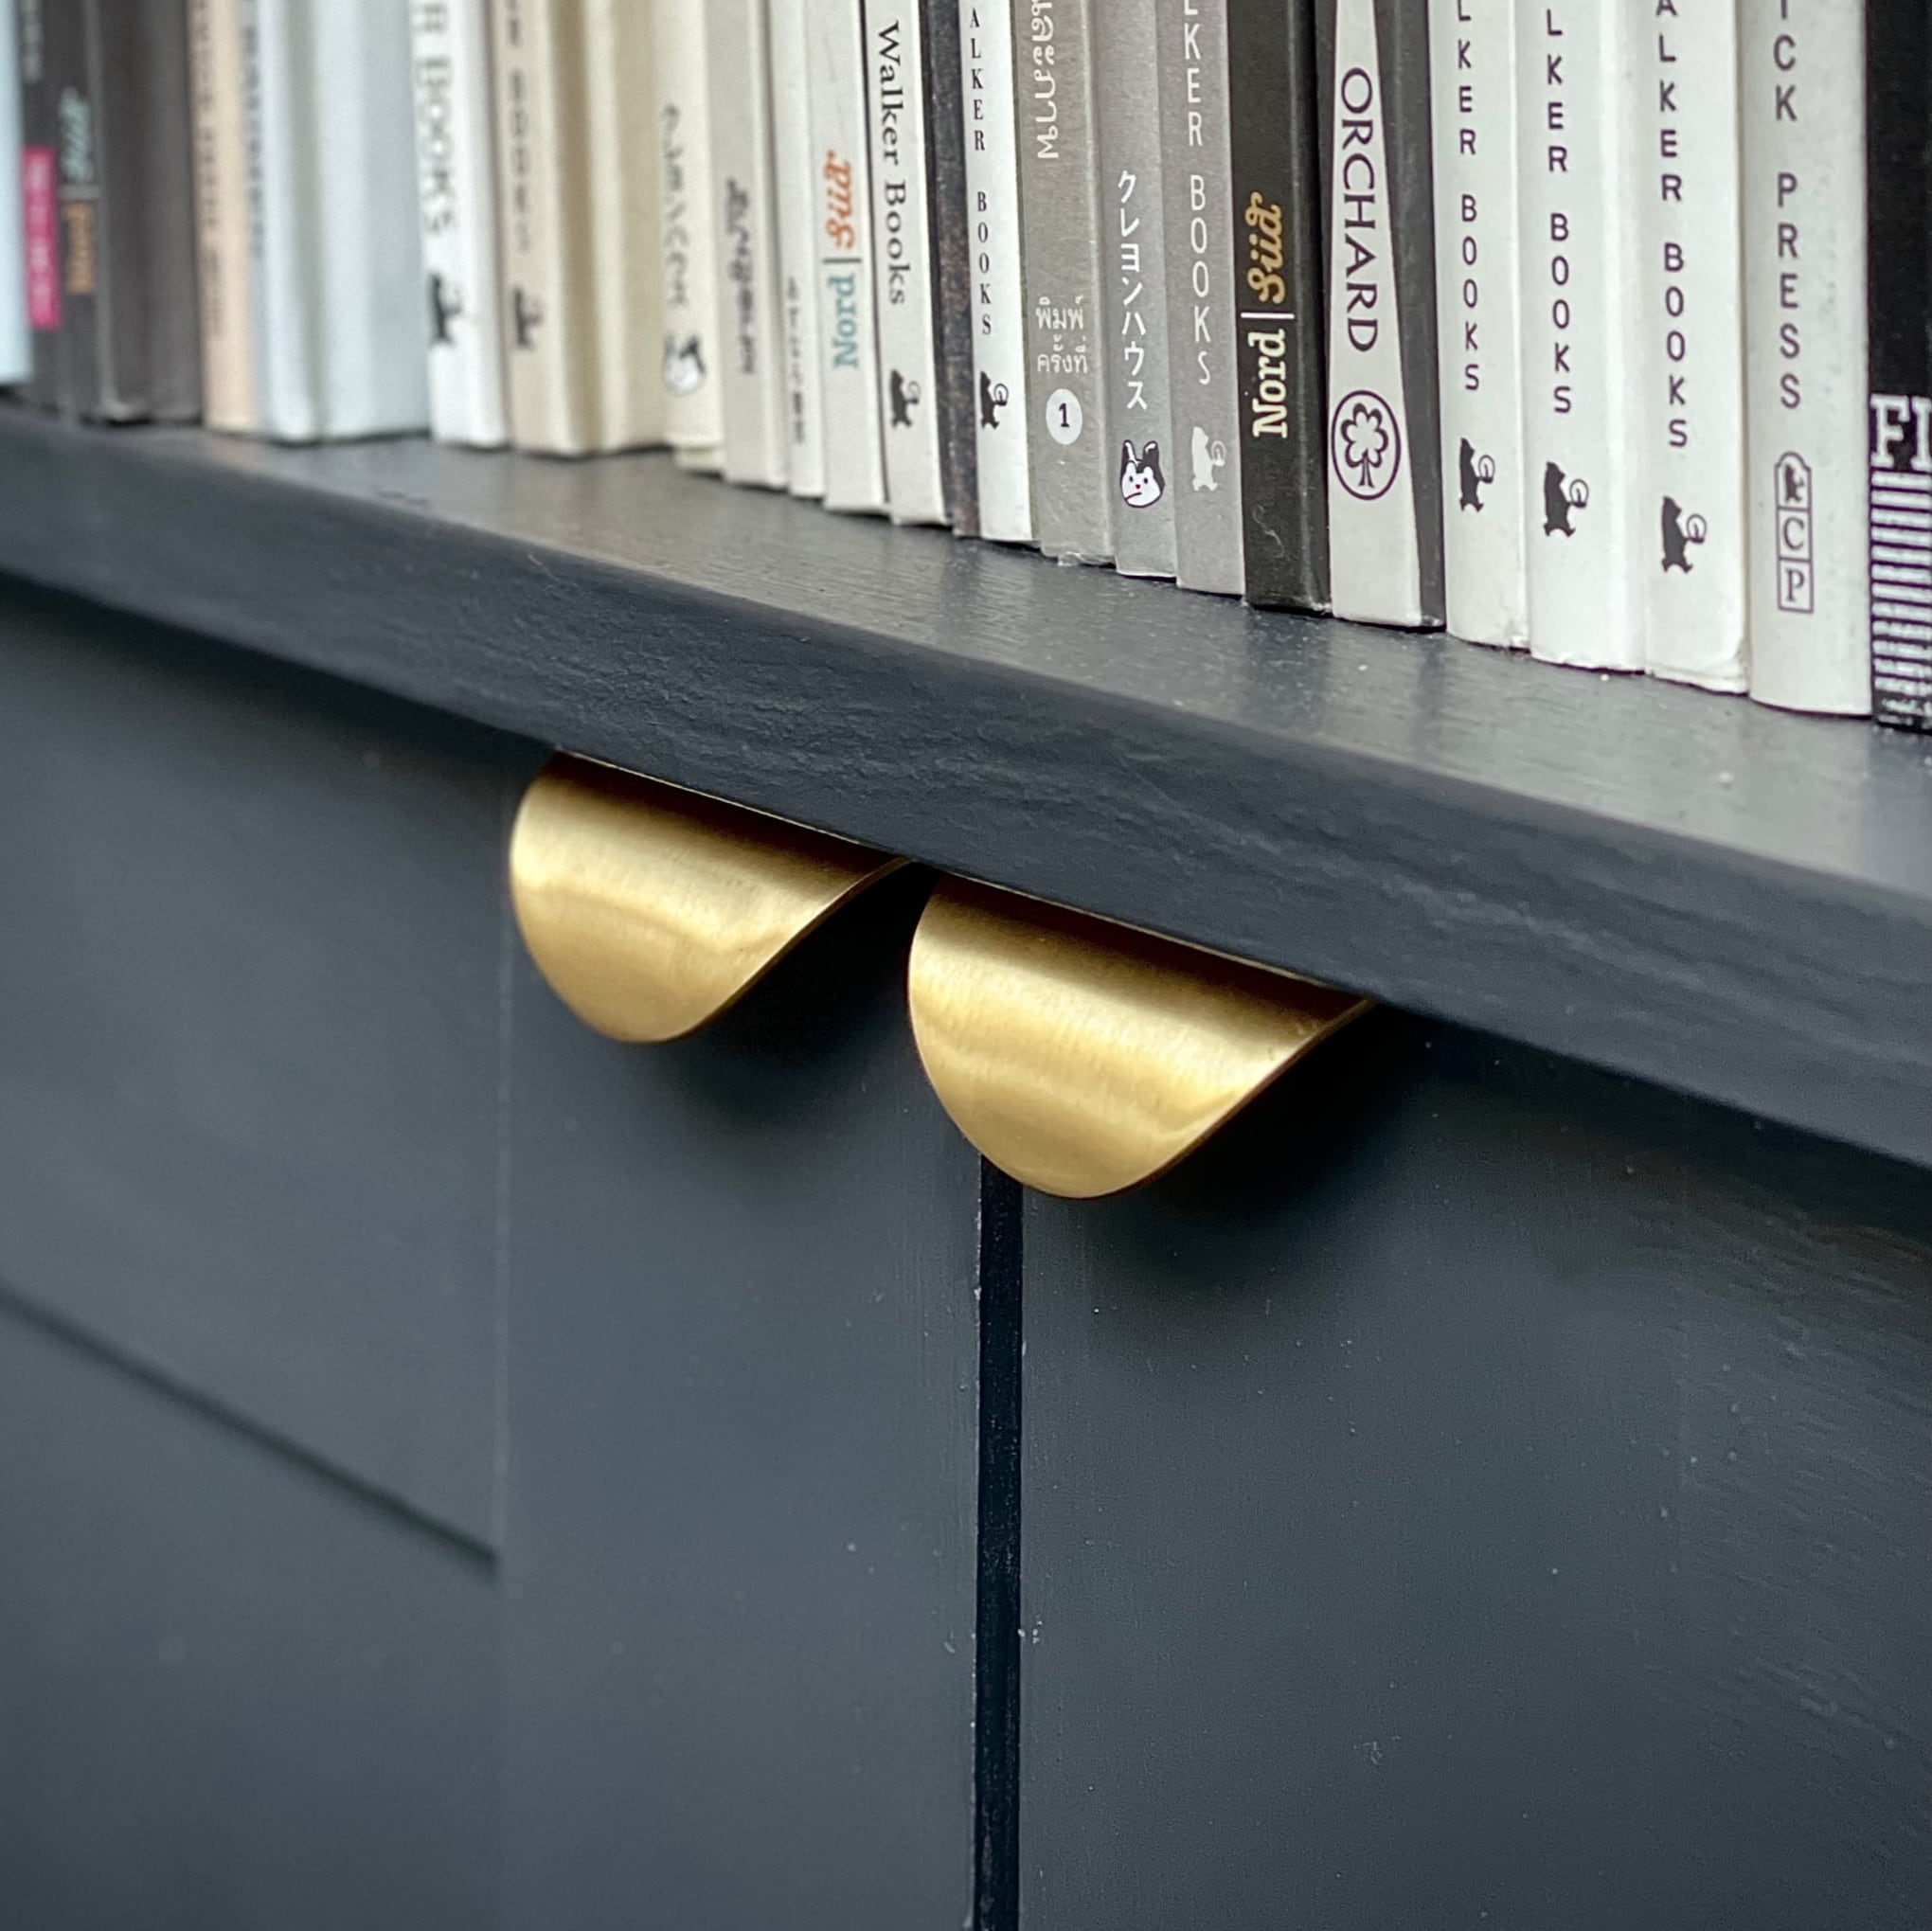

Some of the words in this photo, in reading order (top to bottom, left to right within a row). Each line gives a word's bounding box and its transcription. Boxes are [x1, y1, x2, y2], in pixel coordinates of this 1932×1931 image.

[876, 19, 904, 167] Walker
[969, 8, 987, 152] ALKER
[883, 179, 910, 307] Books
[975, 190, 993, 336] BOOKS
[1190, 175, 1212, 386] BOOKS
[1341, 68, 1379, 352] ORCHARD
[829, 273, 860, 369] Nord
[1035, 295, 1084, 330] พิมพ์
[1036, 333, 1088, 374] ครั้งที่
[1118, 170, 1149, 411] クレヨンハウス
[1461, 194, 1480, 391] BOOKS
[1550, 213, 1573, 415] BOOKS
[1664, 242, 1689, 448] BOOKS
[1777, 171, 1800, 410] PRESS
[1058, 402, 1071, 428] 1
[1247, 328, 1288, 439] Nord
